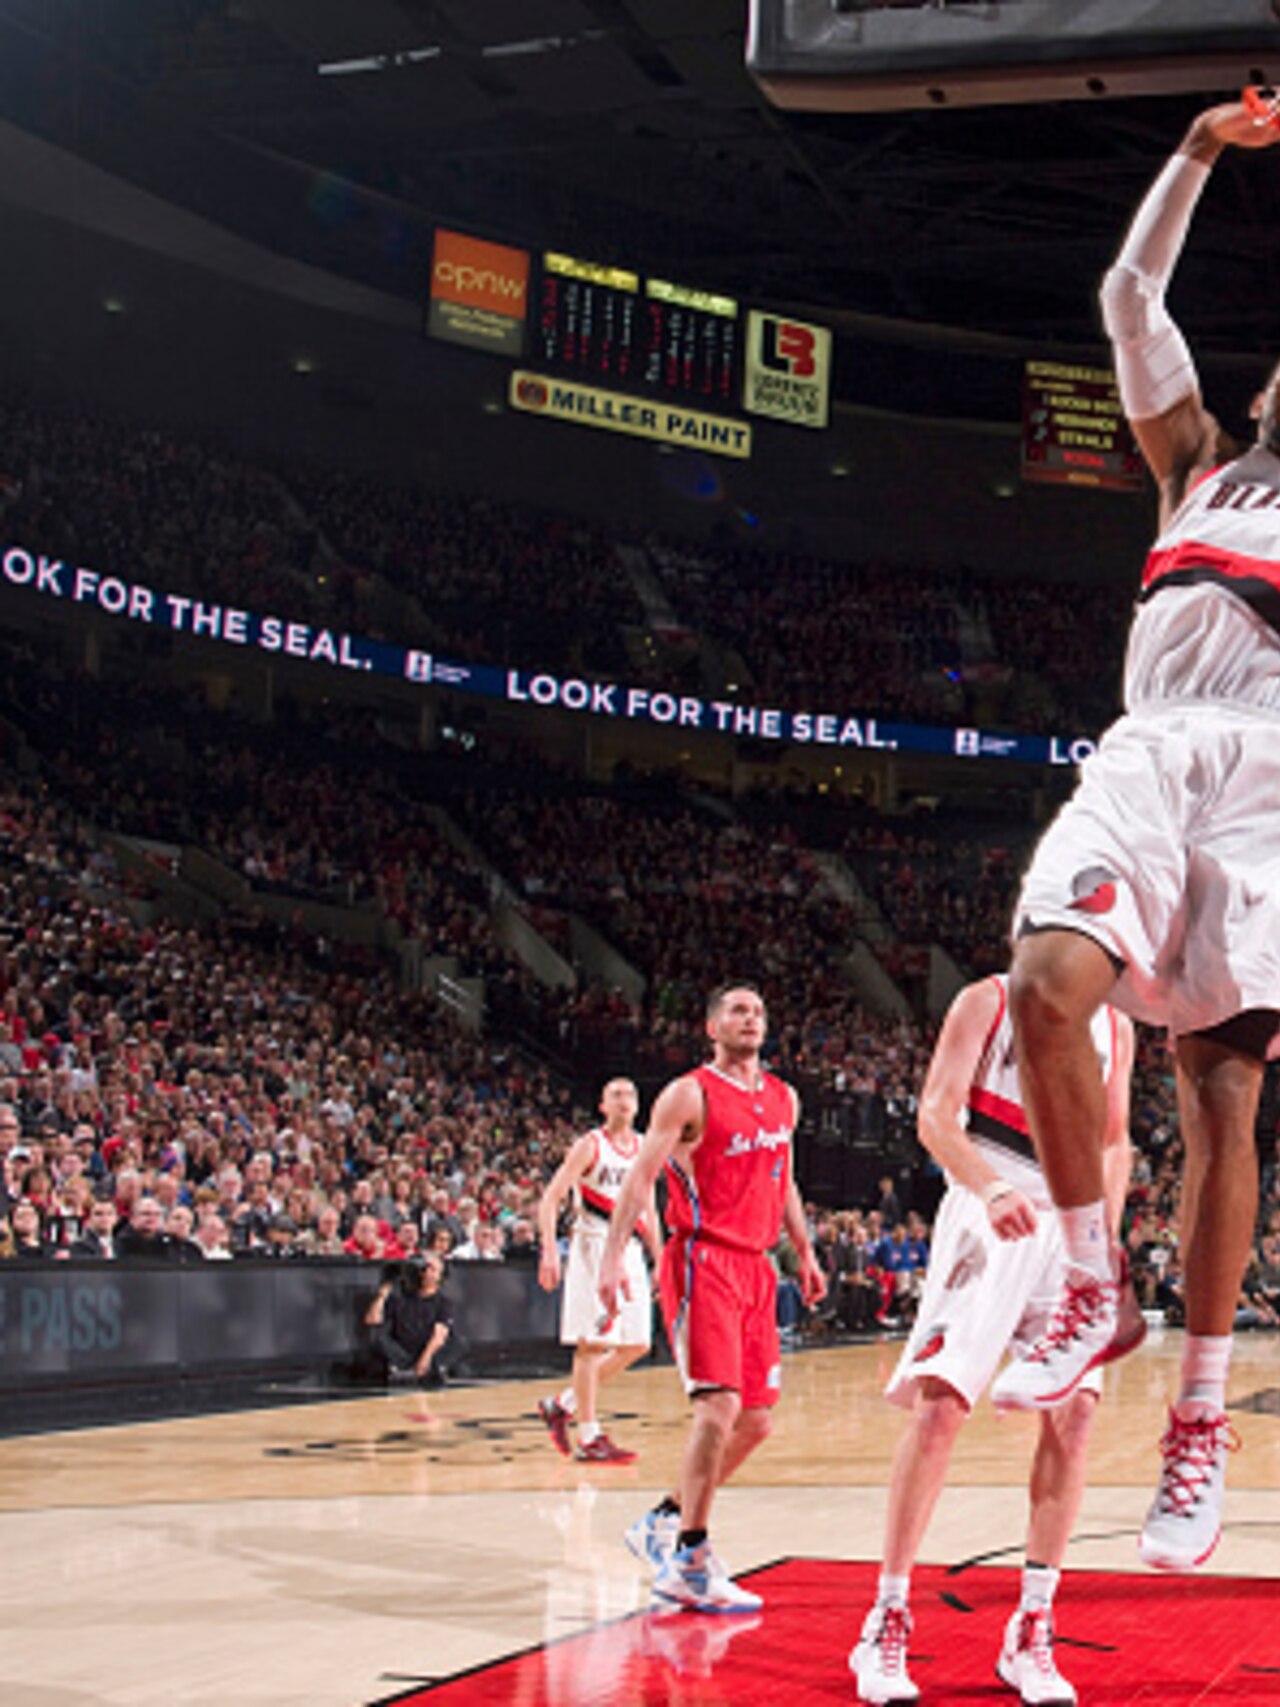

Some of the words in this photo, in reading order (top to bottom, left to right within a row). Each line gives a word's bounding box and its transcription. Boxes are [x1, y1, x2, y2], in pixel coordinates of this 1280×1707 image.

[552, 387, 657, 428] MILLER
[667, 414, 748, 450] PAINT
[73, 568, 154, 622] FOR
[166, 595, 249, 643] THE
[258, 618, 372, 670] SEAL.
[507, 671, 617, 713] LOOK
[627, 690, 701, 726] FOR
[711, 702, 782, 738] THE
[792, 714, 898, 750] SEAL.
[20, 1285, 123, 1354] PASS
